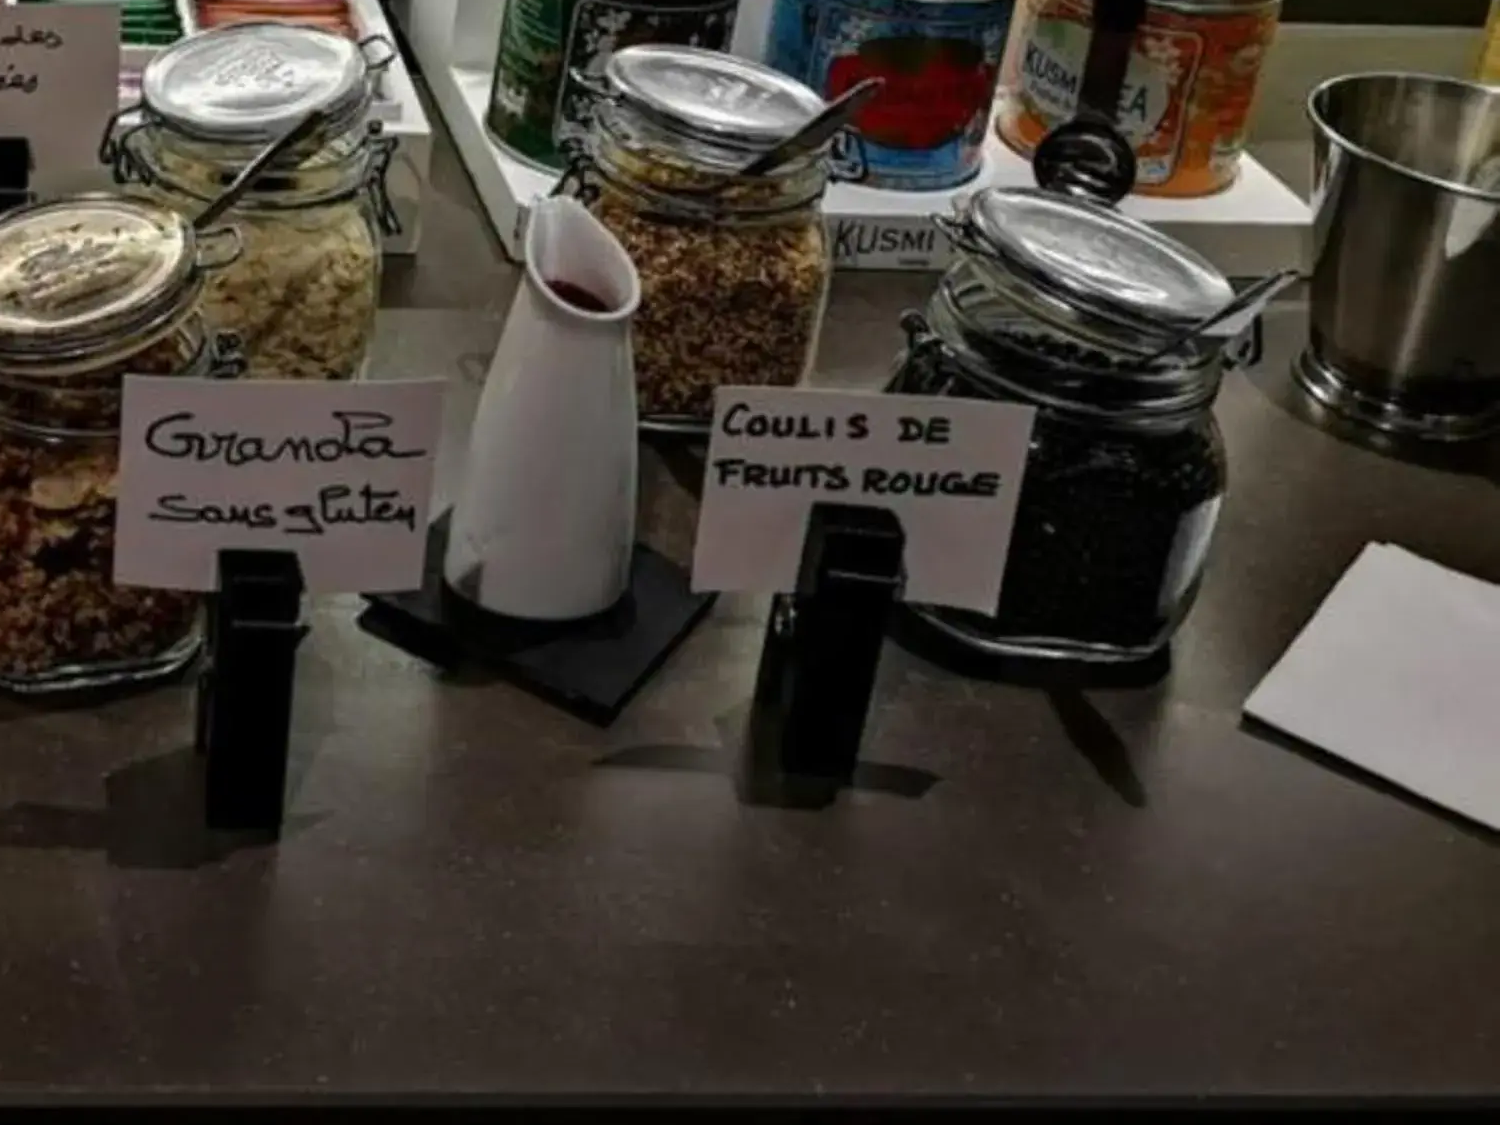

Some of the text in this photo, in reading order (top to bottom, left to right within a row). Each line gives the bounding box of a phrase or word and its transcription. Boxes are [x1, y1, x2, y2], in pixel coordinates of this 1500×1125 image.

[1026, 39, 1078, 96] KUSM
[833, 218, 936, 260] KUSMI
[145, 411, 427, 466] Granola
[722, 402, 951, 444] COULIS DE
[713, 458, 1002, 497] FRUITS ROUGE
